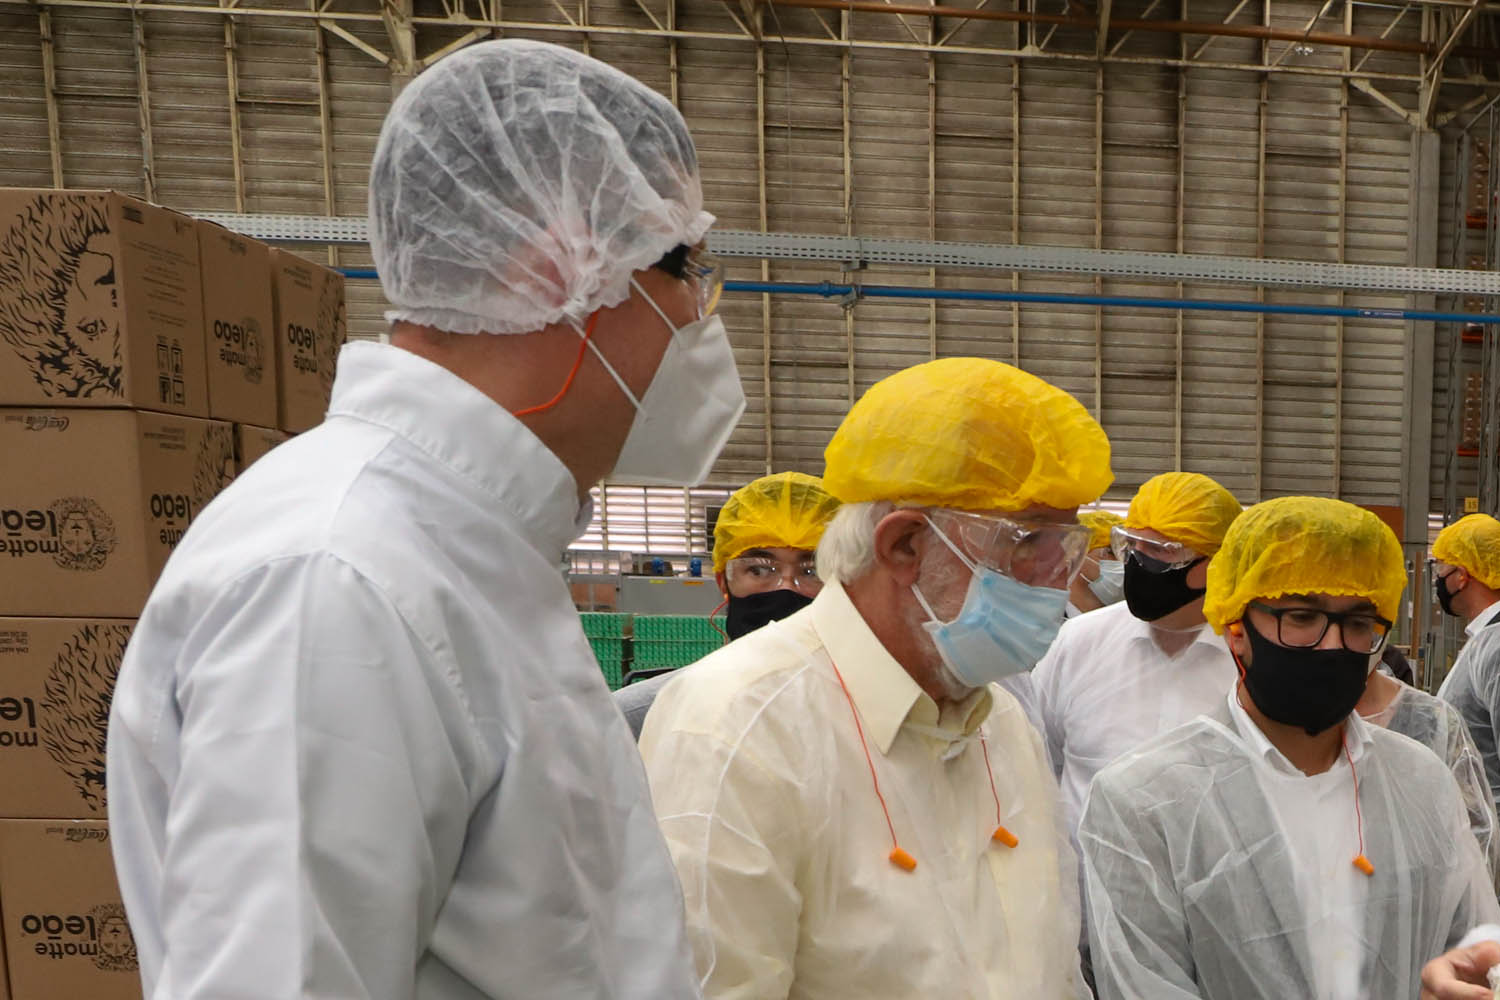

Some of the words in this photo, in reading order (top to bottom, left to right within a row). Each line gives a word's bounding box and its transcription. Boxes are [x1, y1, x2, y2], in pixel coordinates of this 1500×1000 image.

[214, 319, 246, 348] leão
[288, 323, 317, 356] leão
[219, 347, 247, 367] matte
[1467, 501, 1477, 509] 15
[0, 509, 57, 537] leã
[21, 915, 96, 941] leão
[35, 942, 98, 960] matte
